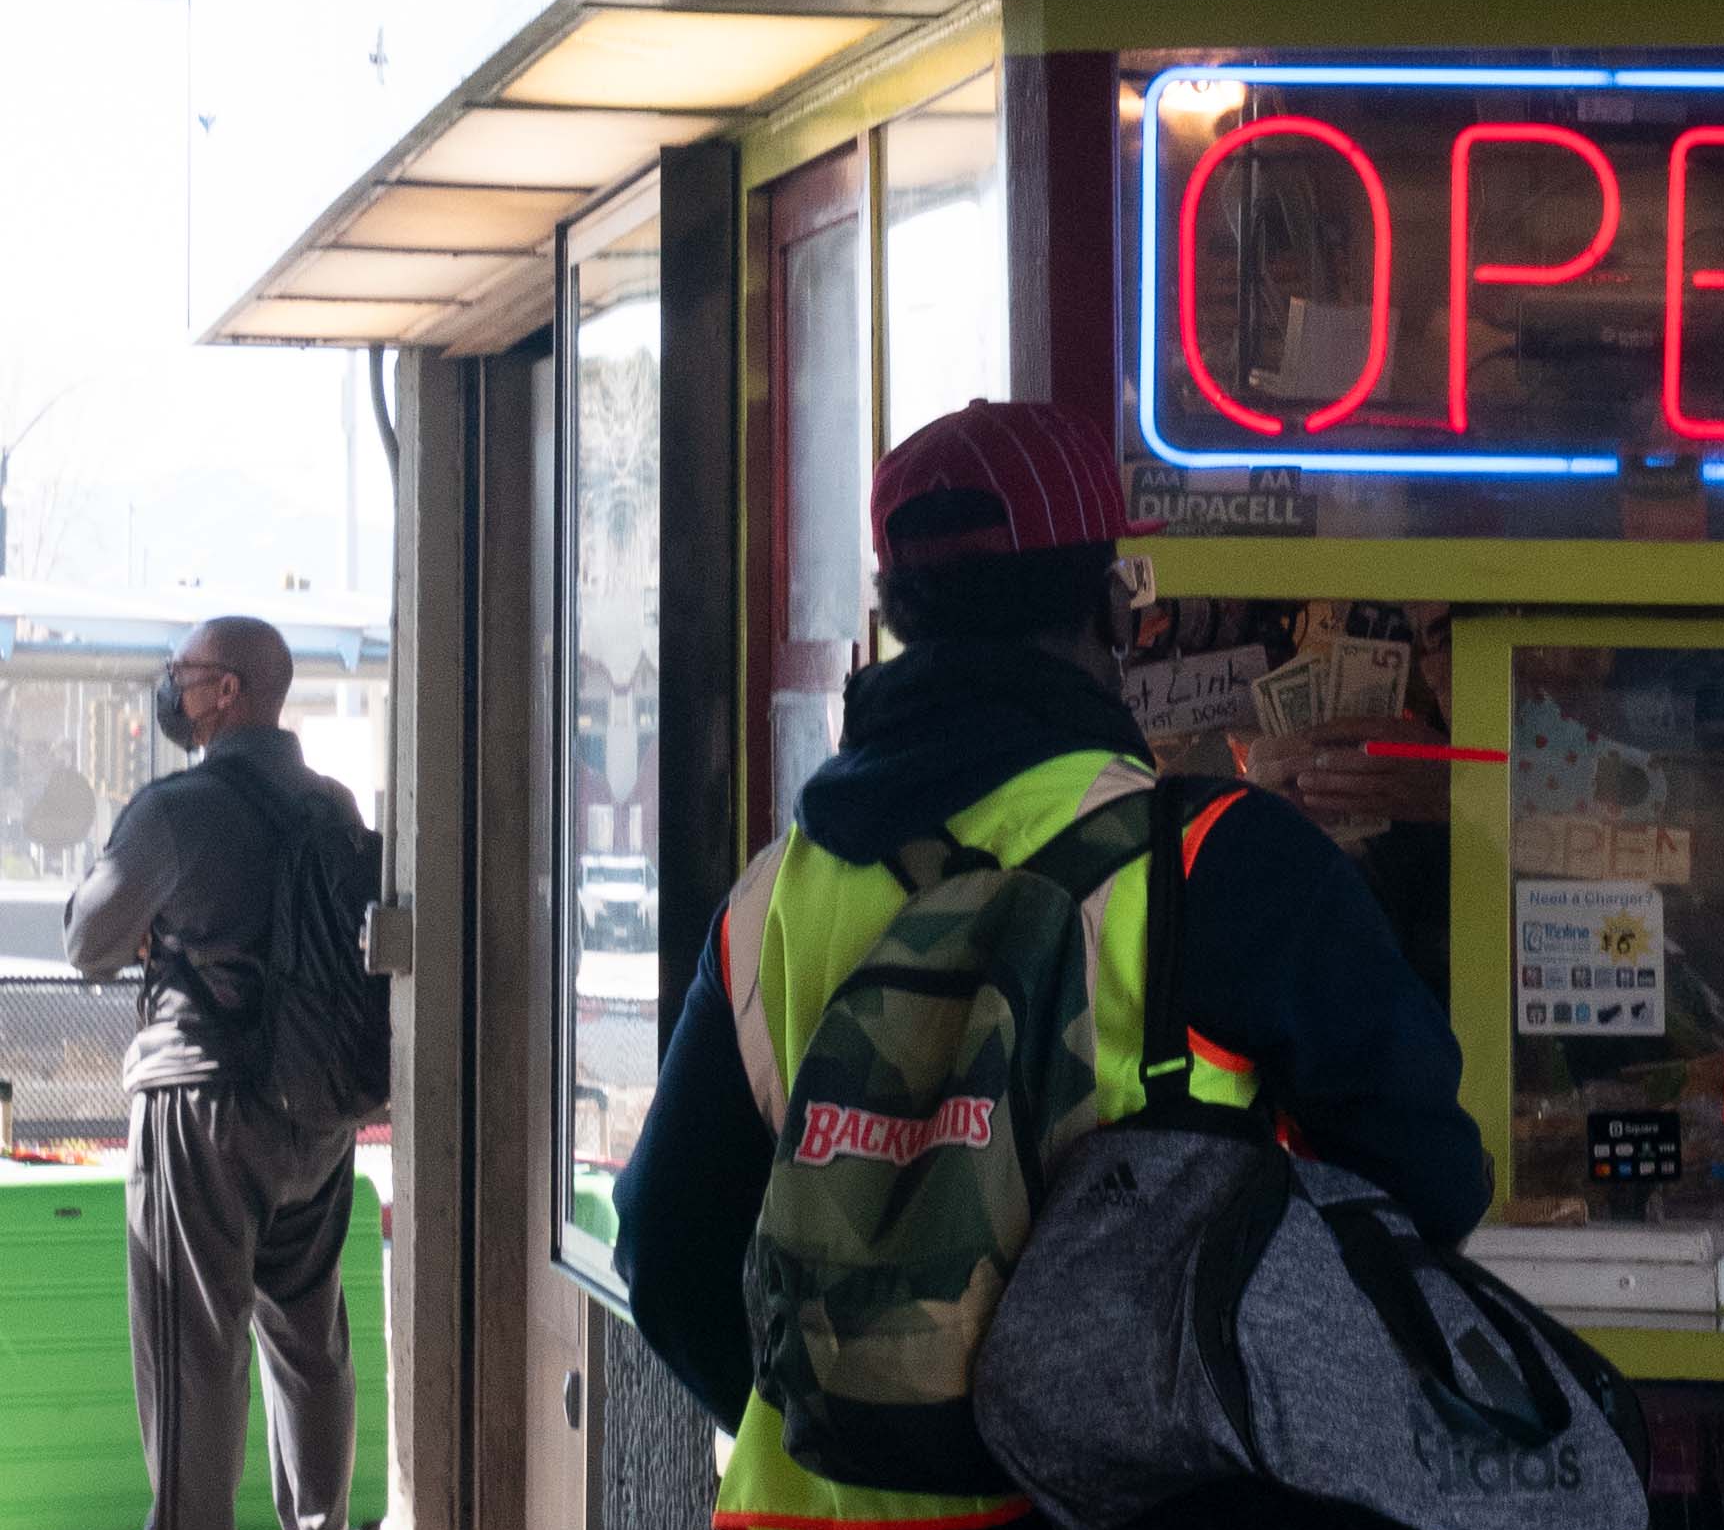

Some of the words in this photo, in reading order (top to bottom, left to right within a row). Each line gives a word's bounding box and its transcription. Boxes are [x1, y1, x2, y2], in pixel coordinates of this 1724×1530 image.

[1140, 472, 1181, 487] AAA
[1259, 470, 1292, 490] AA
[1138, 495, 1302, 524] DURACELL
[1126, 678, 1153, 712] ot
[1167, 659, 1249, 704] Link
[1513, 822, 1696, 877] OPEN
[1529, 892, 1567, 905] Need
[1571, 895, 1580, 905] a
[1584, 891, 1653, 909] Charger?
